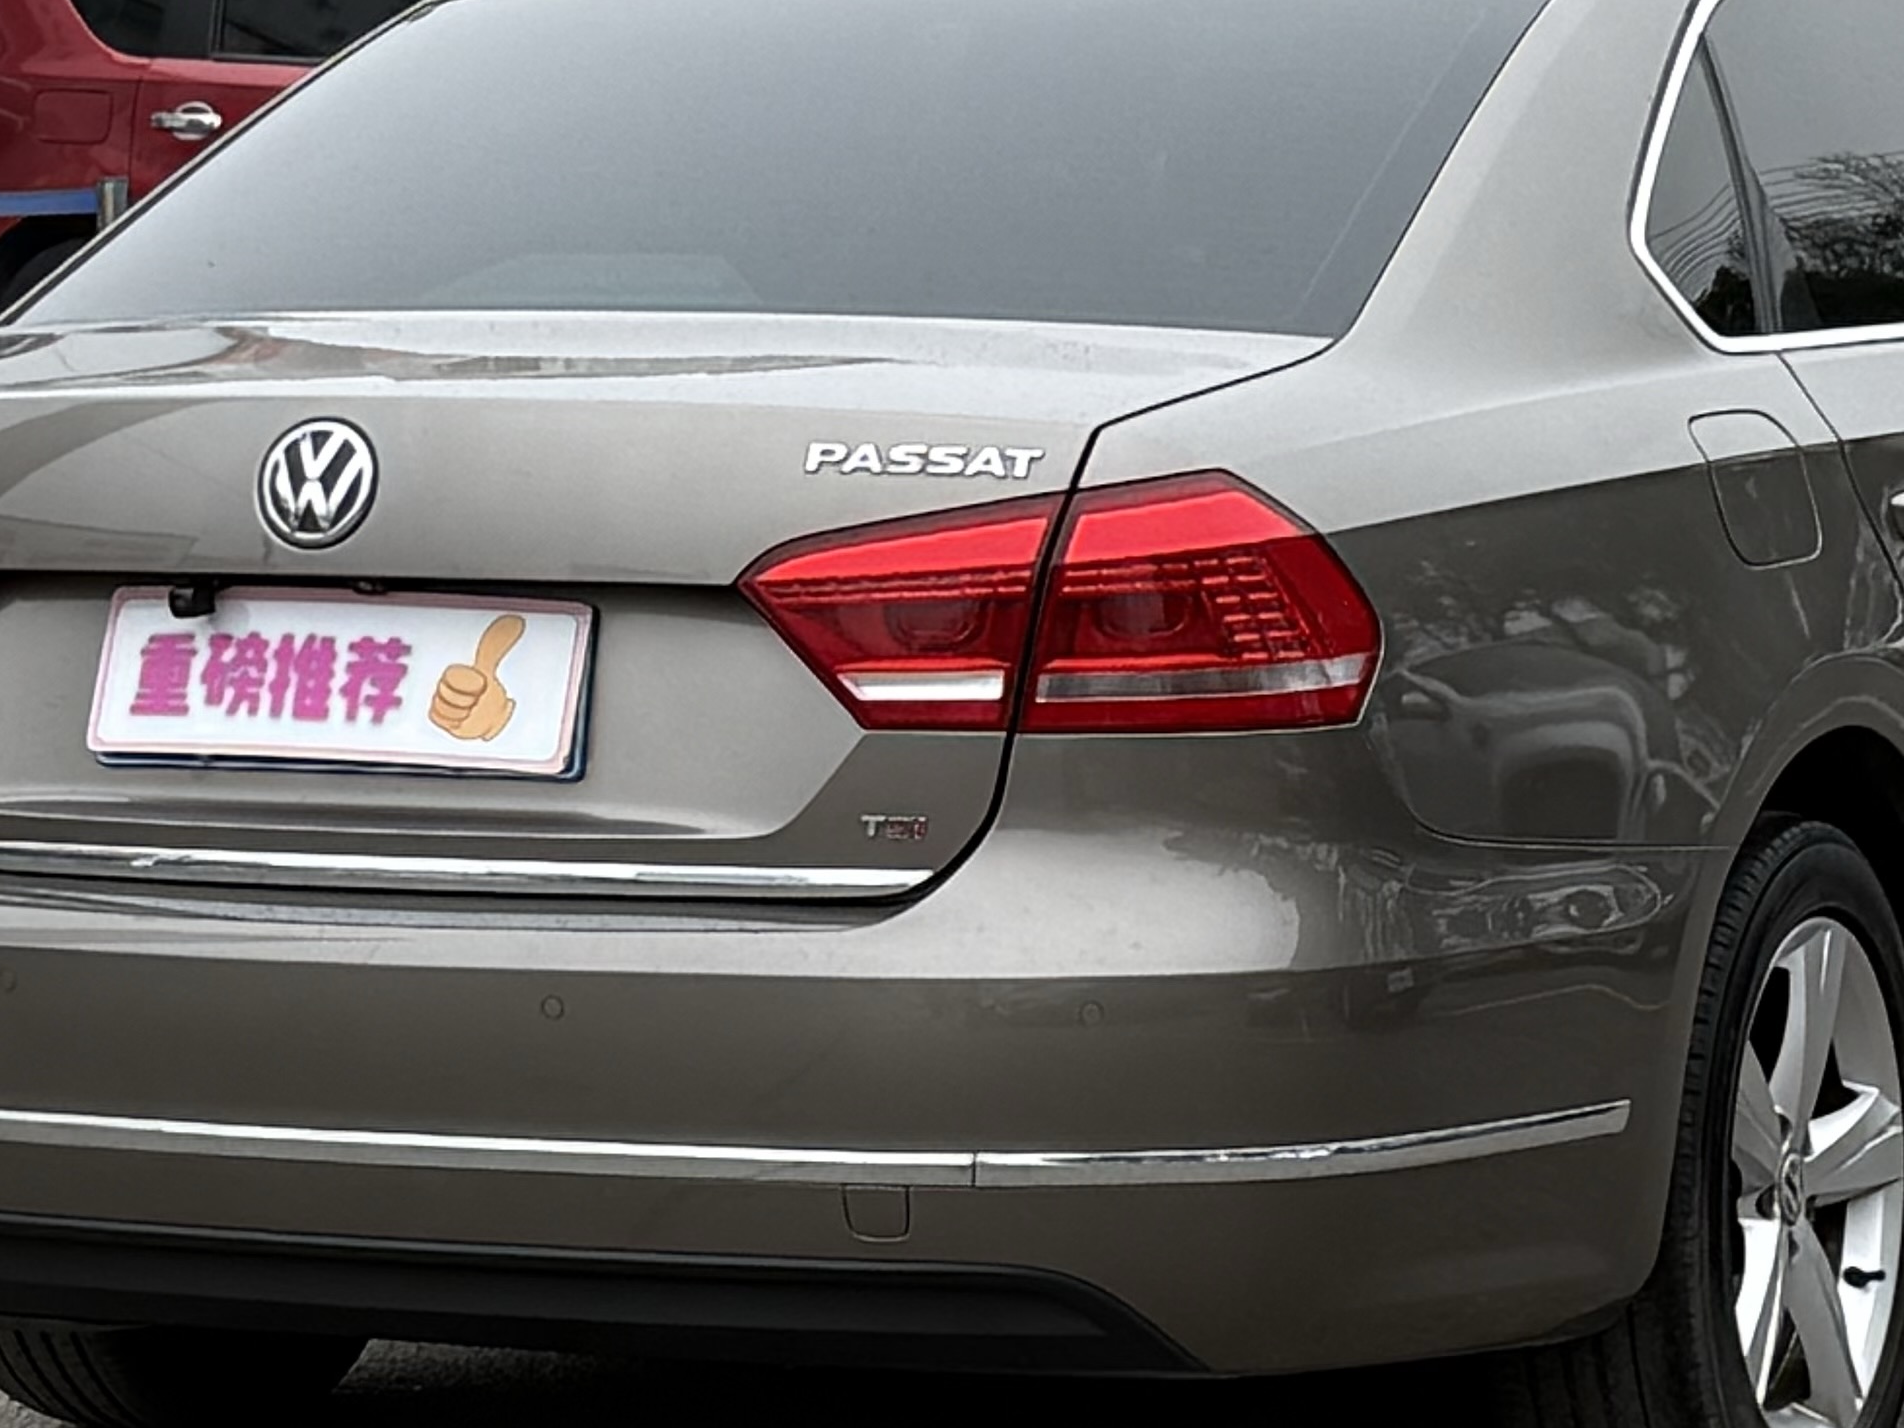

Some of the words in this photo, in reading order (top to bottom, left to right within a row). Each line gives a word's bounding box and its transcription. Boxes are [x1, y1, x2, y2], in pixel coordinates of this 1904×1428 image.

[802, 438, 1046, 481] PASSAT
[128, 627, 414, 726] 重磅推荐
